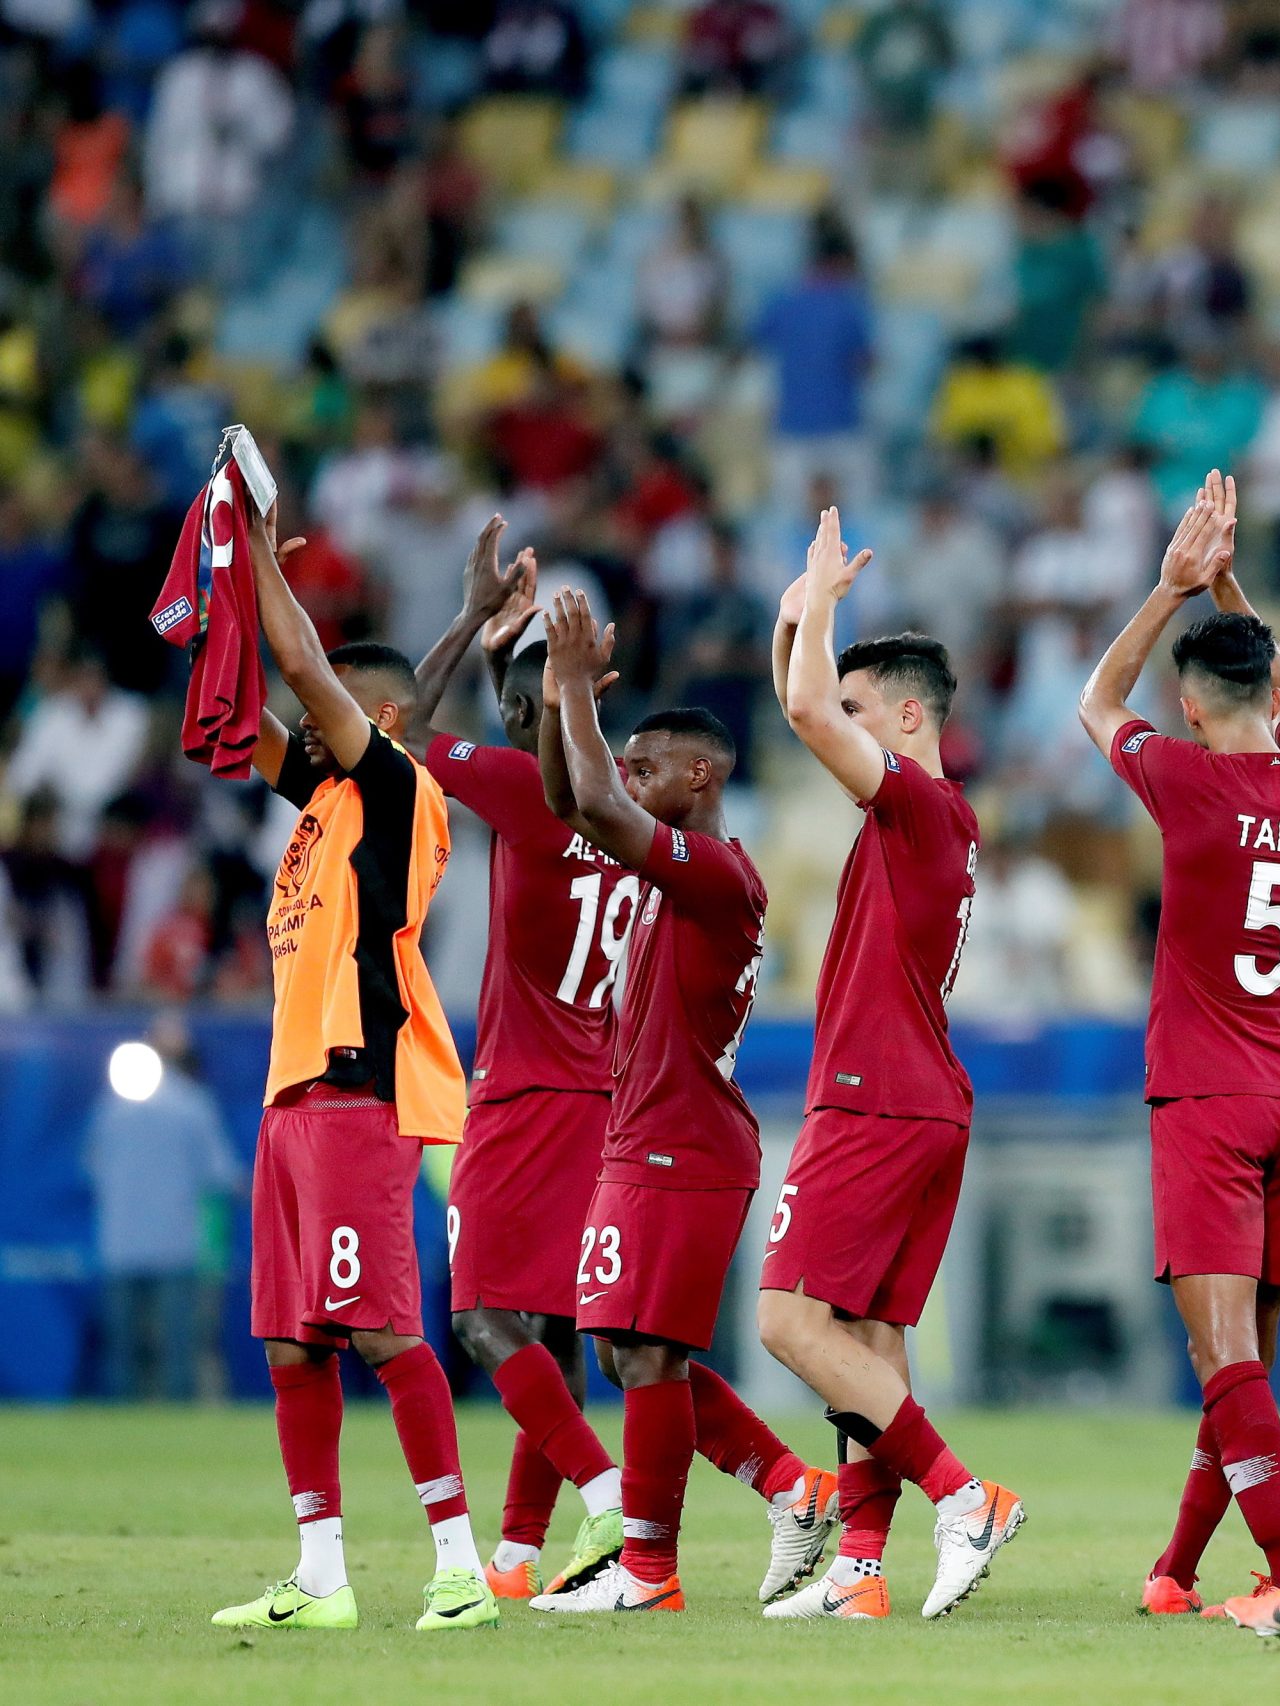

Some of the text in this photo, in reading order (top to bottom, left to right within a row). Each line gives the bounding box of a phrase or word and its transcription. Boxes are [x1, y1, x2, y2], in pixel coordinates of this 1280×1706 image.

[155, 601, 186, 624] Cree en
[159, 608, 187, 632] grande
[556, 872, 640, 1008] 19
[447, 1205, 461, 1265] 9
[769, 1184, 799, 1243] 5
[329, 1226, 361, 1289] 8
[576, 1225, 622, 1285] 23
